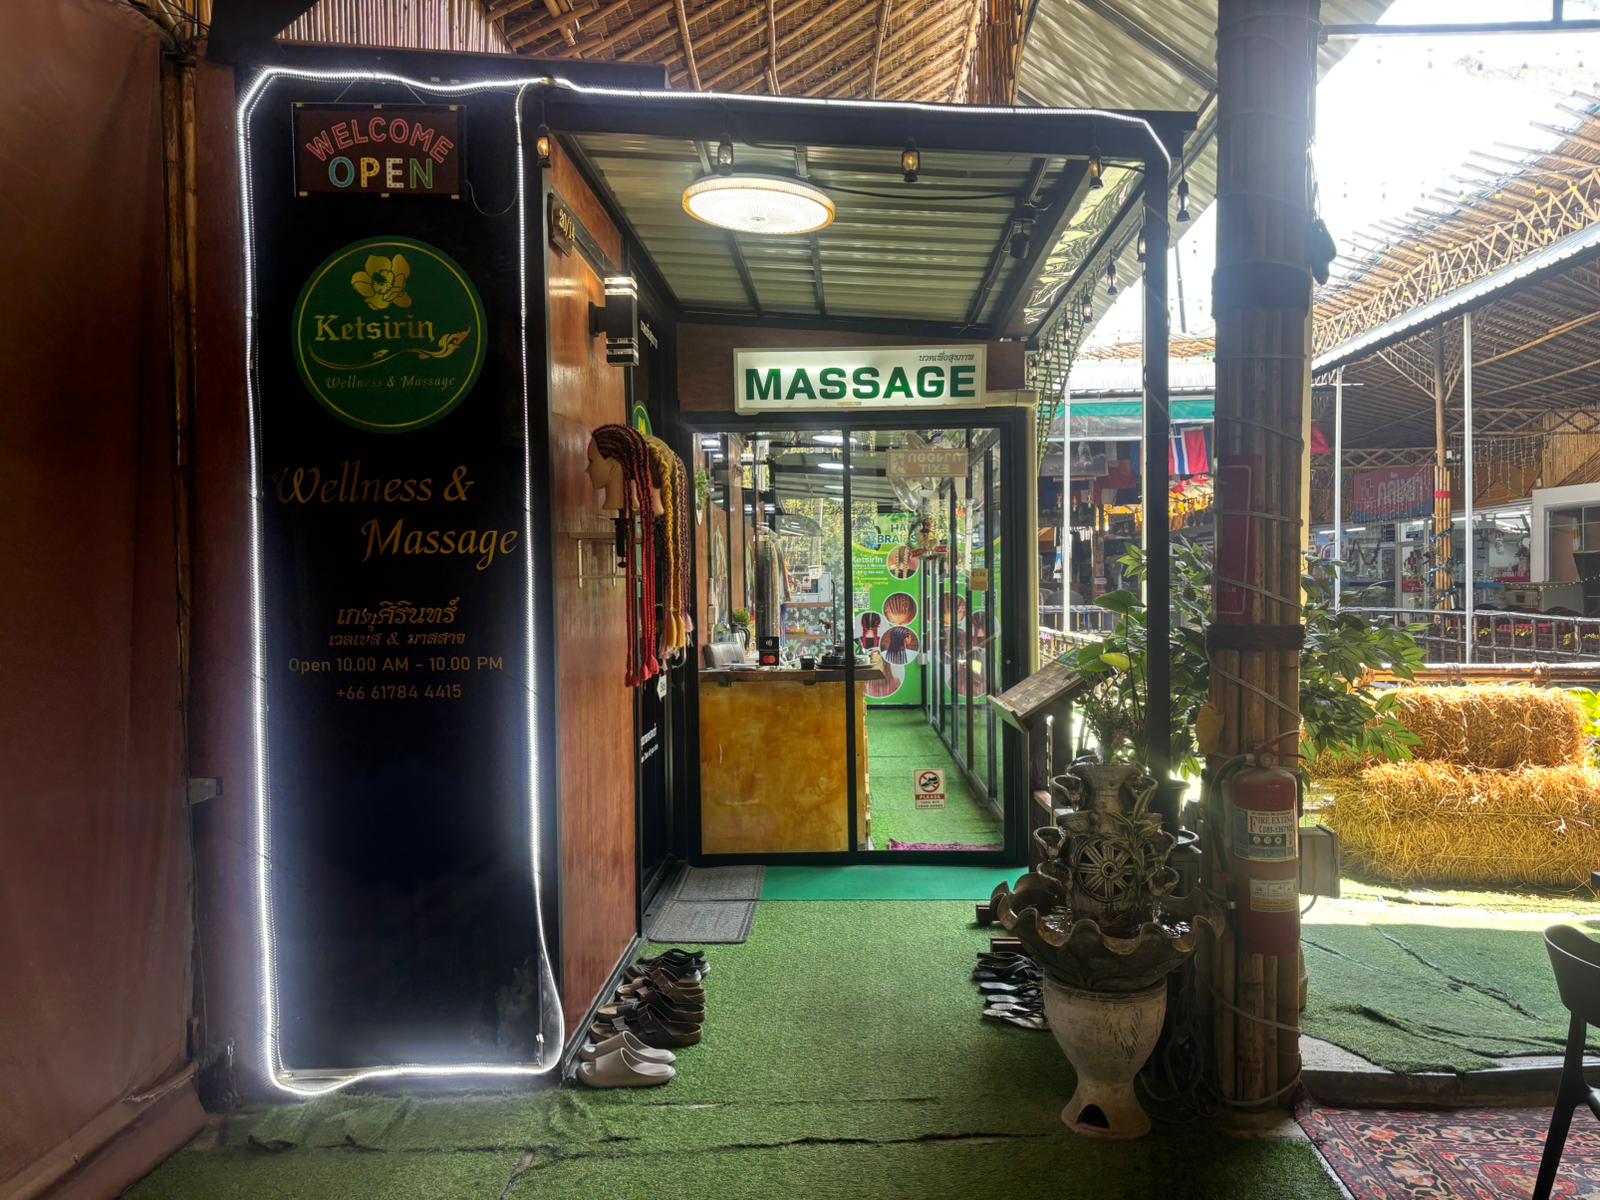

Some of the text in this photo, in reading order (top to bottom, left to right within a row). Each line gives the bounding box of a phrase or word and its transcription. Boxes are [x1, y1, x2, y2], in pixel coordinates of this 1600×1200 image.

[305, 117, 454, 162] WELCOME
[328, 157, 433, 188] OPEN
[313, 312, 435, 345] Ketsirin
[324, 374, 455, 390] Wellness & Massage
[746, 366, 976, 400] MASSAGE
[274, 460, 475, 505] Wellness &
[361, 518, 518, 571] Massage
[386, 631, 400, 646] &
[288, 657, 331, 674] Open
[336, 657, 376, 671] 10.00
[382, 657, 409, 671] AM
[429, 656, 470, 671] 10.00
[477, 656, 504, 670] PM
[336, 684, 462, 700] +66 61784 4415
